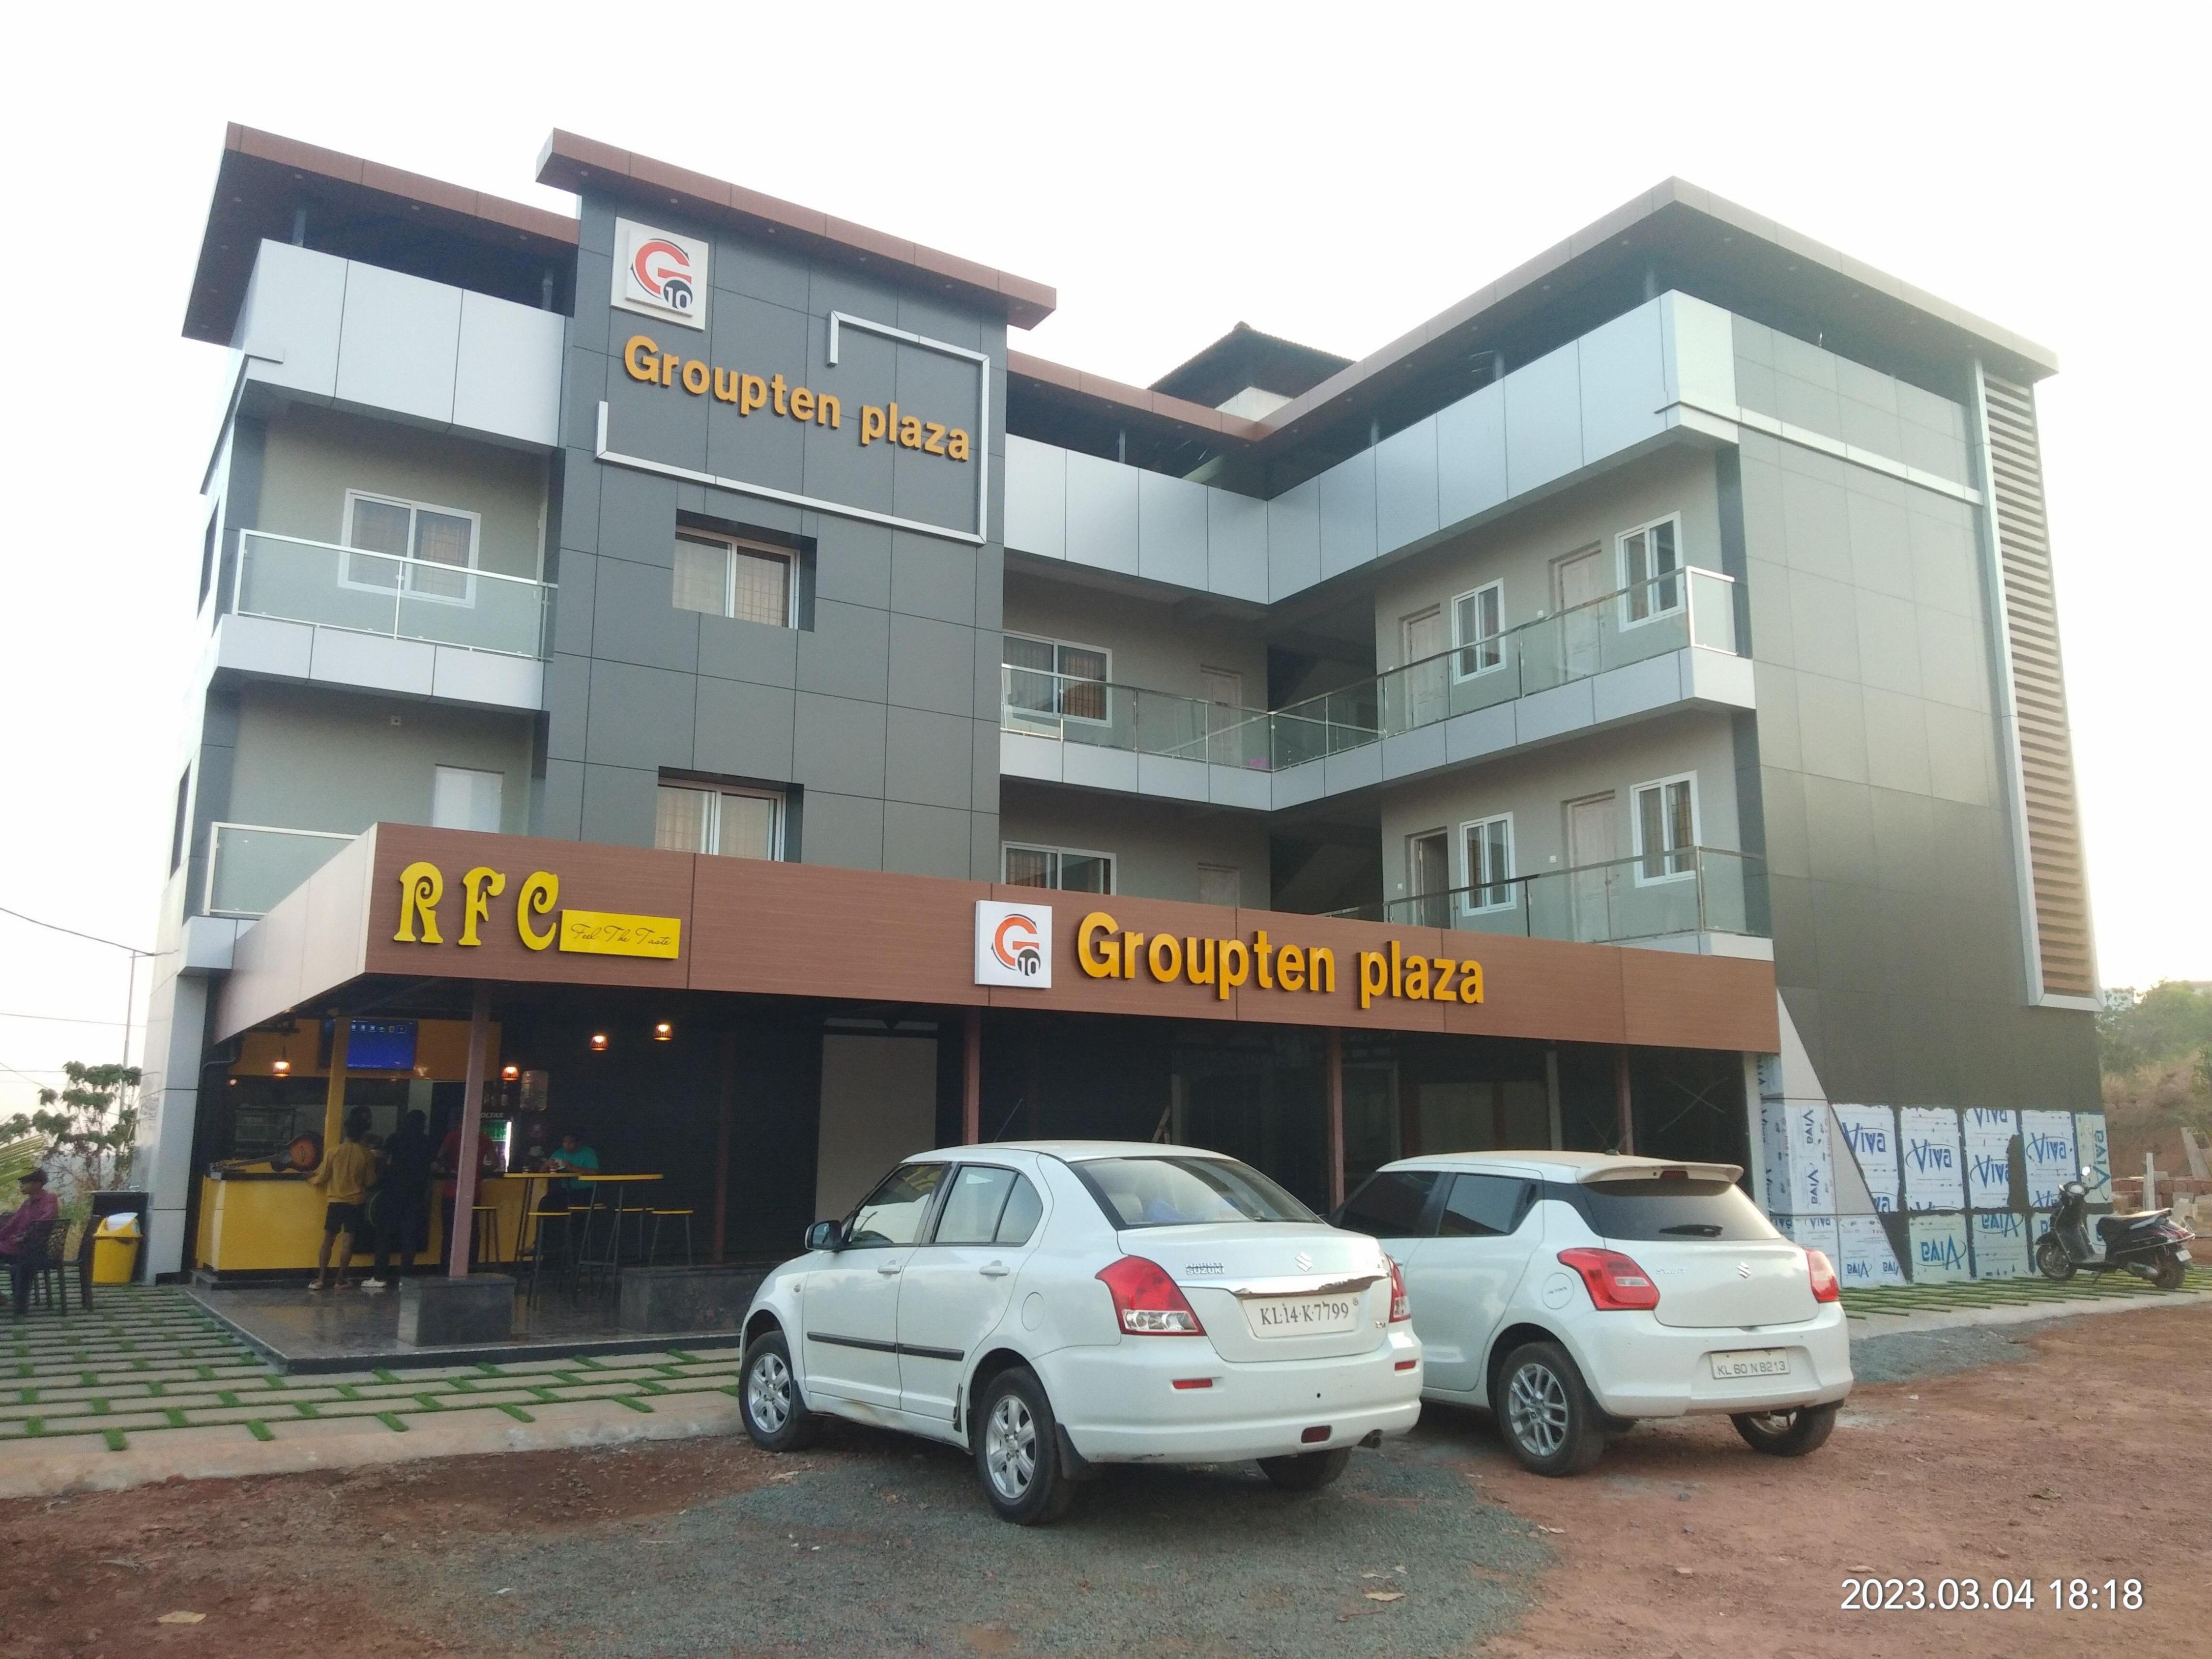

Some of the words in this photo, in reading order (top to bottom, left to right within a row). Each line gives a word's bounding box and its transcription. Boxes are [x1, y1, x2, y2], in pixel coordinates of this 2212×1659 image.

[625, 335, 840, 428] Groupten
[862, 402, 969, 461] plaza
[571, 923, 602, 939] Feel
[604, 925, 631, 942] The
[635, 928, 671, 945] Taste
[1077, 911, 1336, 1000] Groupten
[1359, 940, 1484, 1009] plaza
[1717, 1365, 1732, 1375] KL
